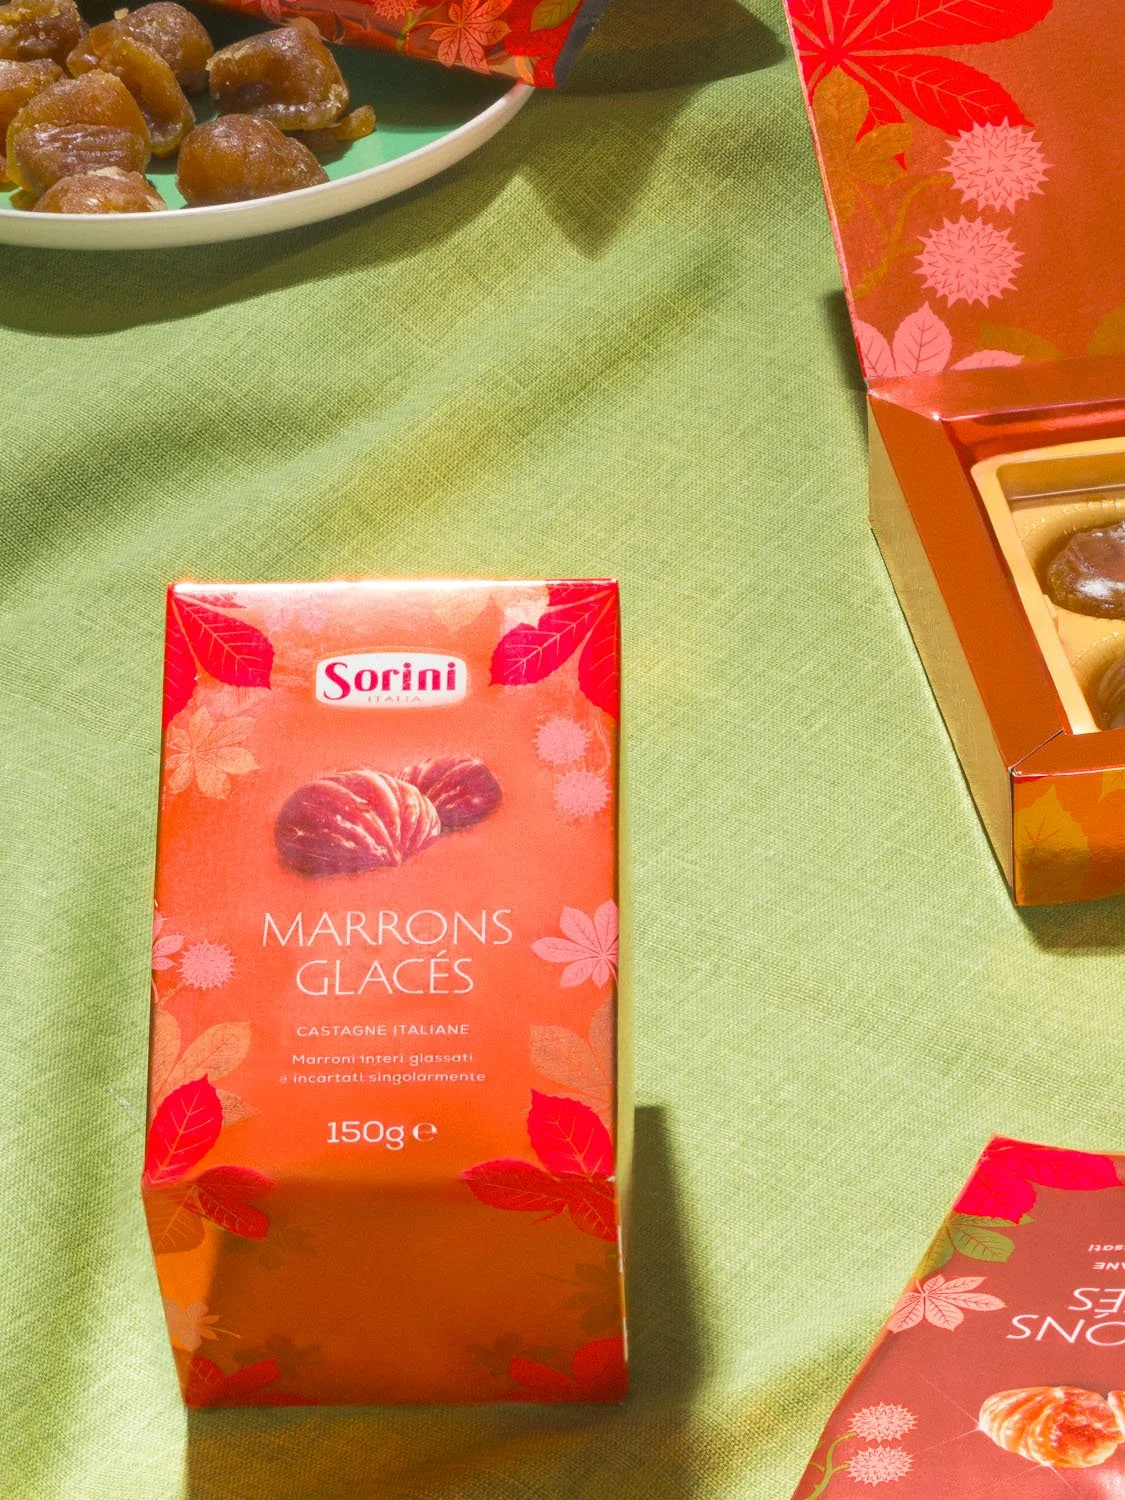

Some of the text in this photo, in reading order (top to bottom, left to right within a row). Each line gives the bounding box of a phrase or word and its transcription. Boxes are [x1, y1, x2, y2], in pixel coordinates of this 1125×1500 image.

[323, 662, 456, 700] Sorini
[262, 909, 513, 947] MARRONS
[296, 949, 474, 996] GLACÉS
[297, 1024, 470, 1037] CASTAGNE ITALIANE
[292, 1053, 473, 1067] Marroni interi glassati
[293, 1072, 363, 1084] incartati
[369, 1071, 486, 1086] singolarmente
[327, 1120, 405, 1151] 150g
